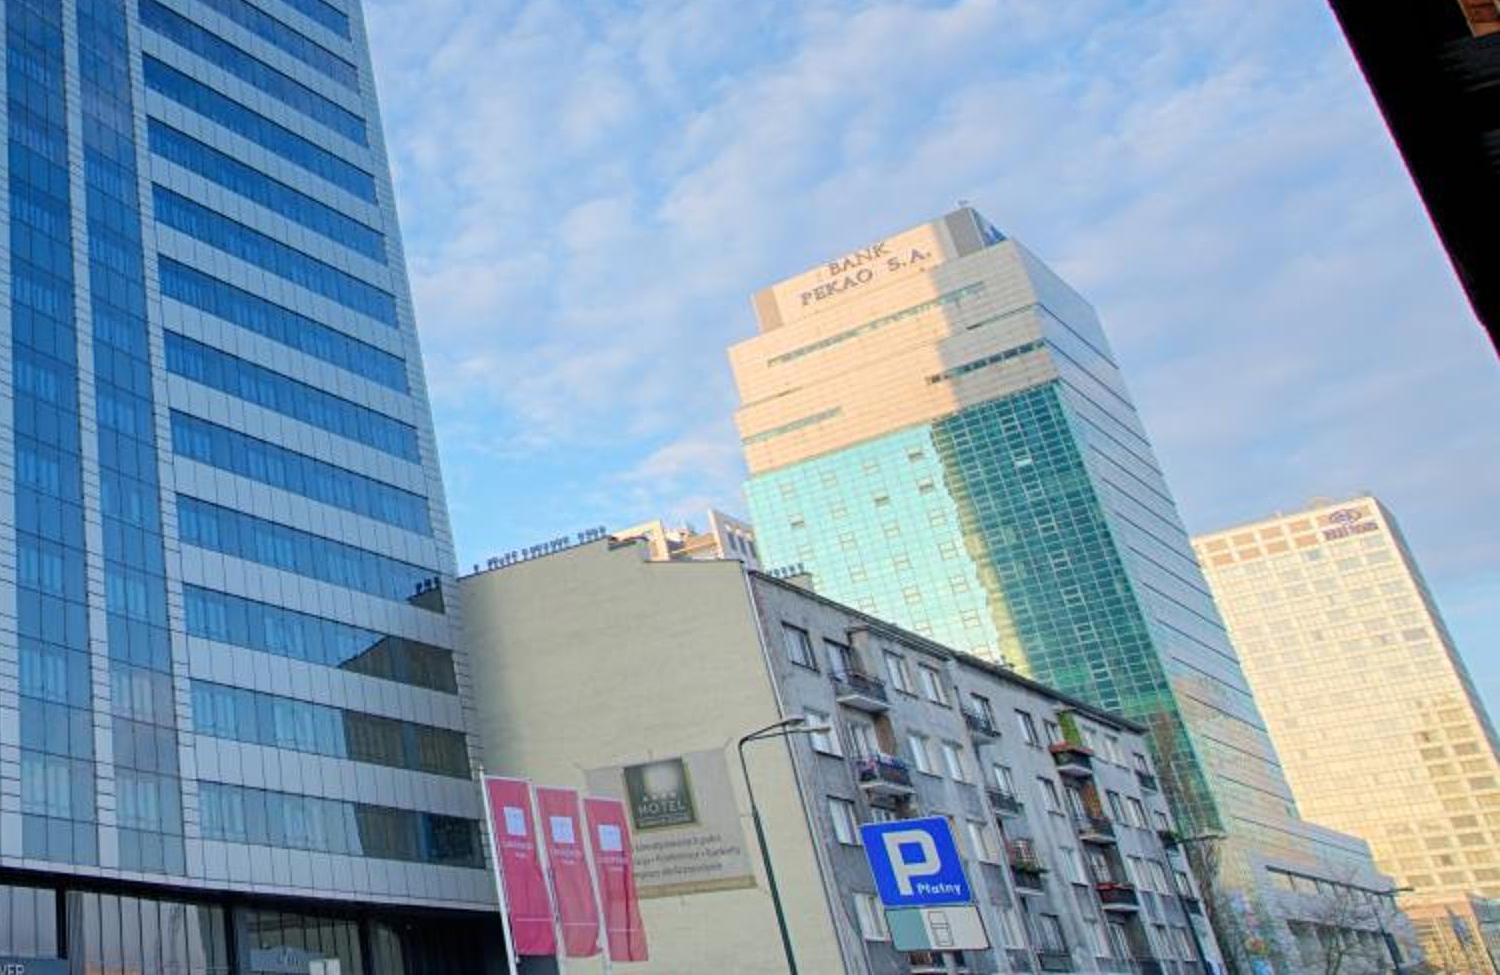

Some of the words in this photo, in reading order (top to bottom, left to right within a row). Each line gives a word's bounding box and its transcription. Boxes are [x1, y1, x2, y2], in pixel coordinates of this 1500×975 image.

[801, 268, 873, 305] PEKAO
[887, 248, 932, 272] S.A.
[828, 242, 891, 276] BANK
[637, 800, 686, 817] HOTEL
[881, 828, 941, 896] P
